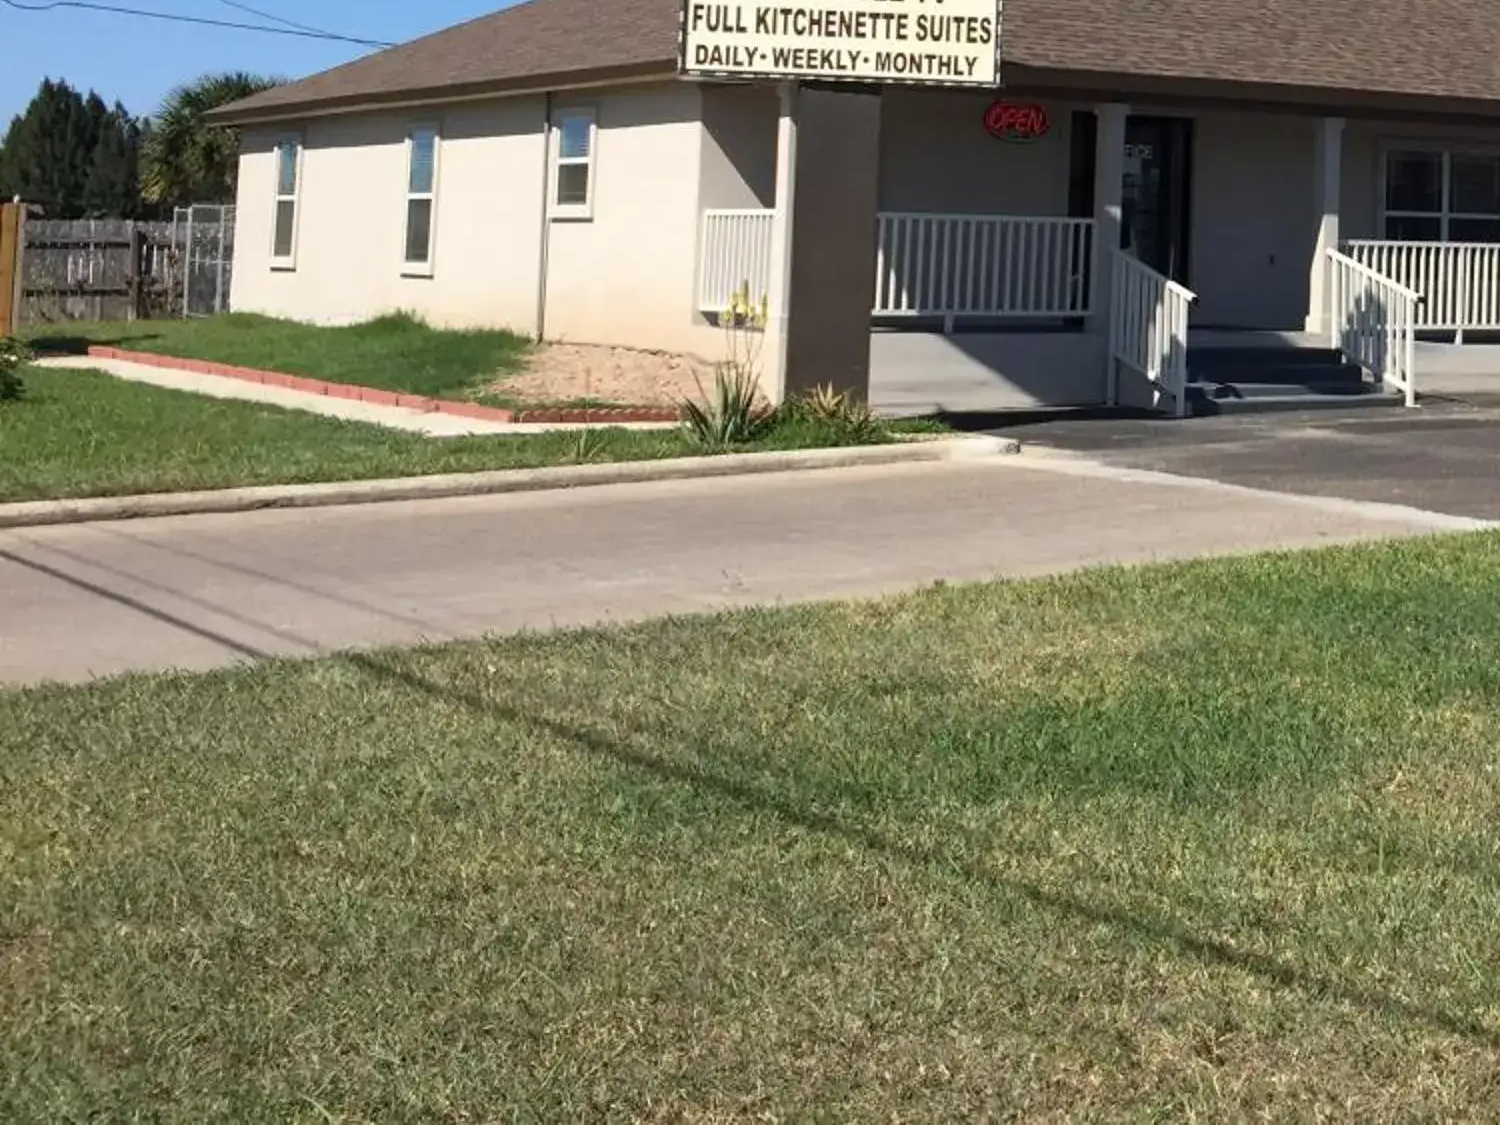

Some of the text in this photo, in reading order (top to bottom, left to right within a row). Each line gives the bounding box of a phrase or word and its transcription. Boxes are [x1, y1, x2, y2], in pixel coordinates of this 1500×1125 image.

[692, 3, 991, 44] FULL KITCHENETTE SUITES
[875, 51, 978, 76] MONTHLY
[987, 105, 1046, 136] OPEN
